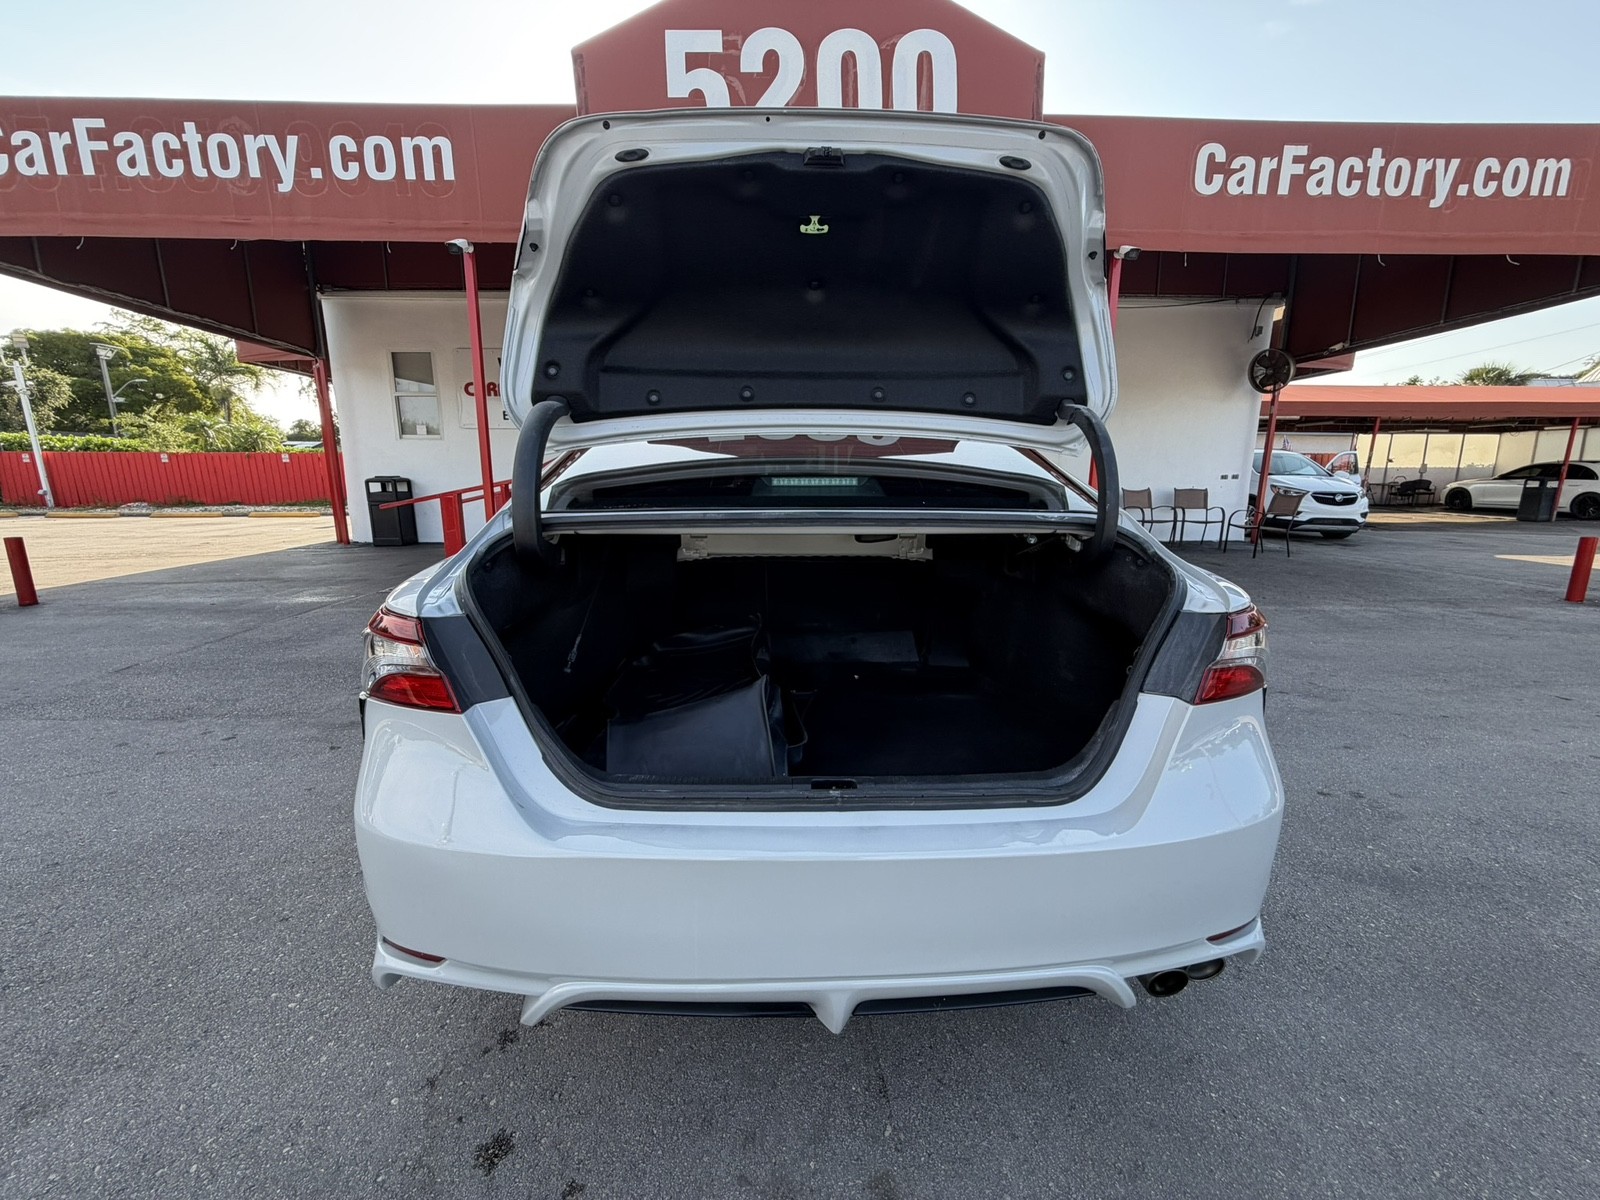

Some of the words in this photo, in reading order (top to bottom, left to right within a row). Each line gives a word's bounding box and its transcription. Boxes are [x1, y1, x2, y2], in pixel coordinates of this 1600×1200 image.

[664, 27, 958, 114] 5200
[0, 117, 456, 193] arFactory.com
[1194, 142, 1572, 208] CarFactory.com
